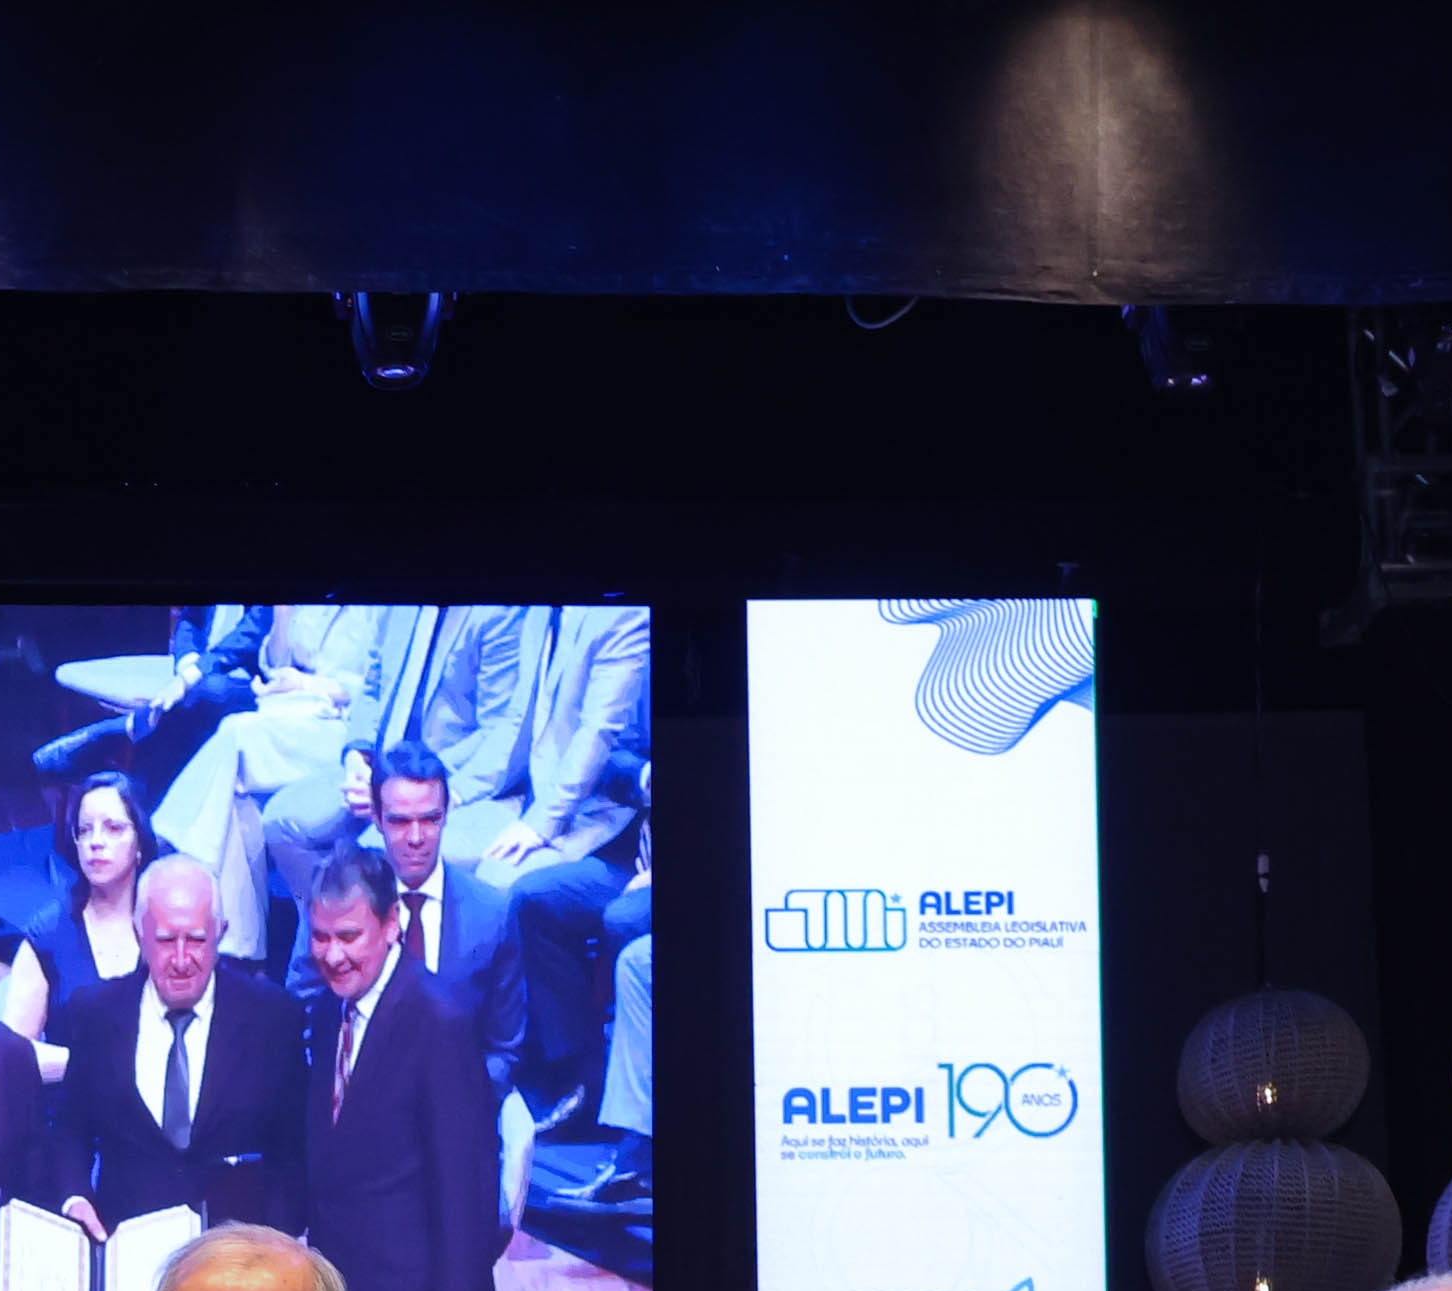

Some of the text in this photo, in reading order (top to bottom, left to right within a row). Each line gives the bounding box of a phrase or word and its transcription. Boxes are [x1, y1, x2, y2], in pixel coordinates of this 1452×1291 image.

[919, 891, 1014, 915] ALEPI
[919, 921, 1087, 933] ASSEMBLEIA LEGISLATIVA
[919, 935, 1064, 949] DO ESTADO DO PIAUÍ
[782, 1063, 1078, 1138] ALEPI 190 ANOS
[781, 1135, 808, 1148] Aqui
[811, 1138, 825, 1147] se
[828, 1136, 847, 1150] faz
[902, 1136, 929, 1149] aqui
[781, 1150, 795, 1160] se
